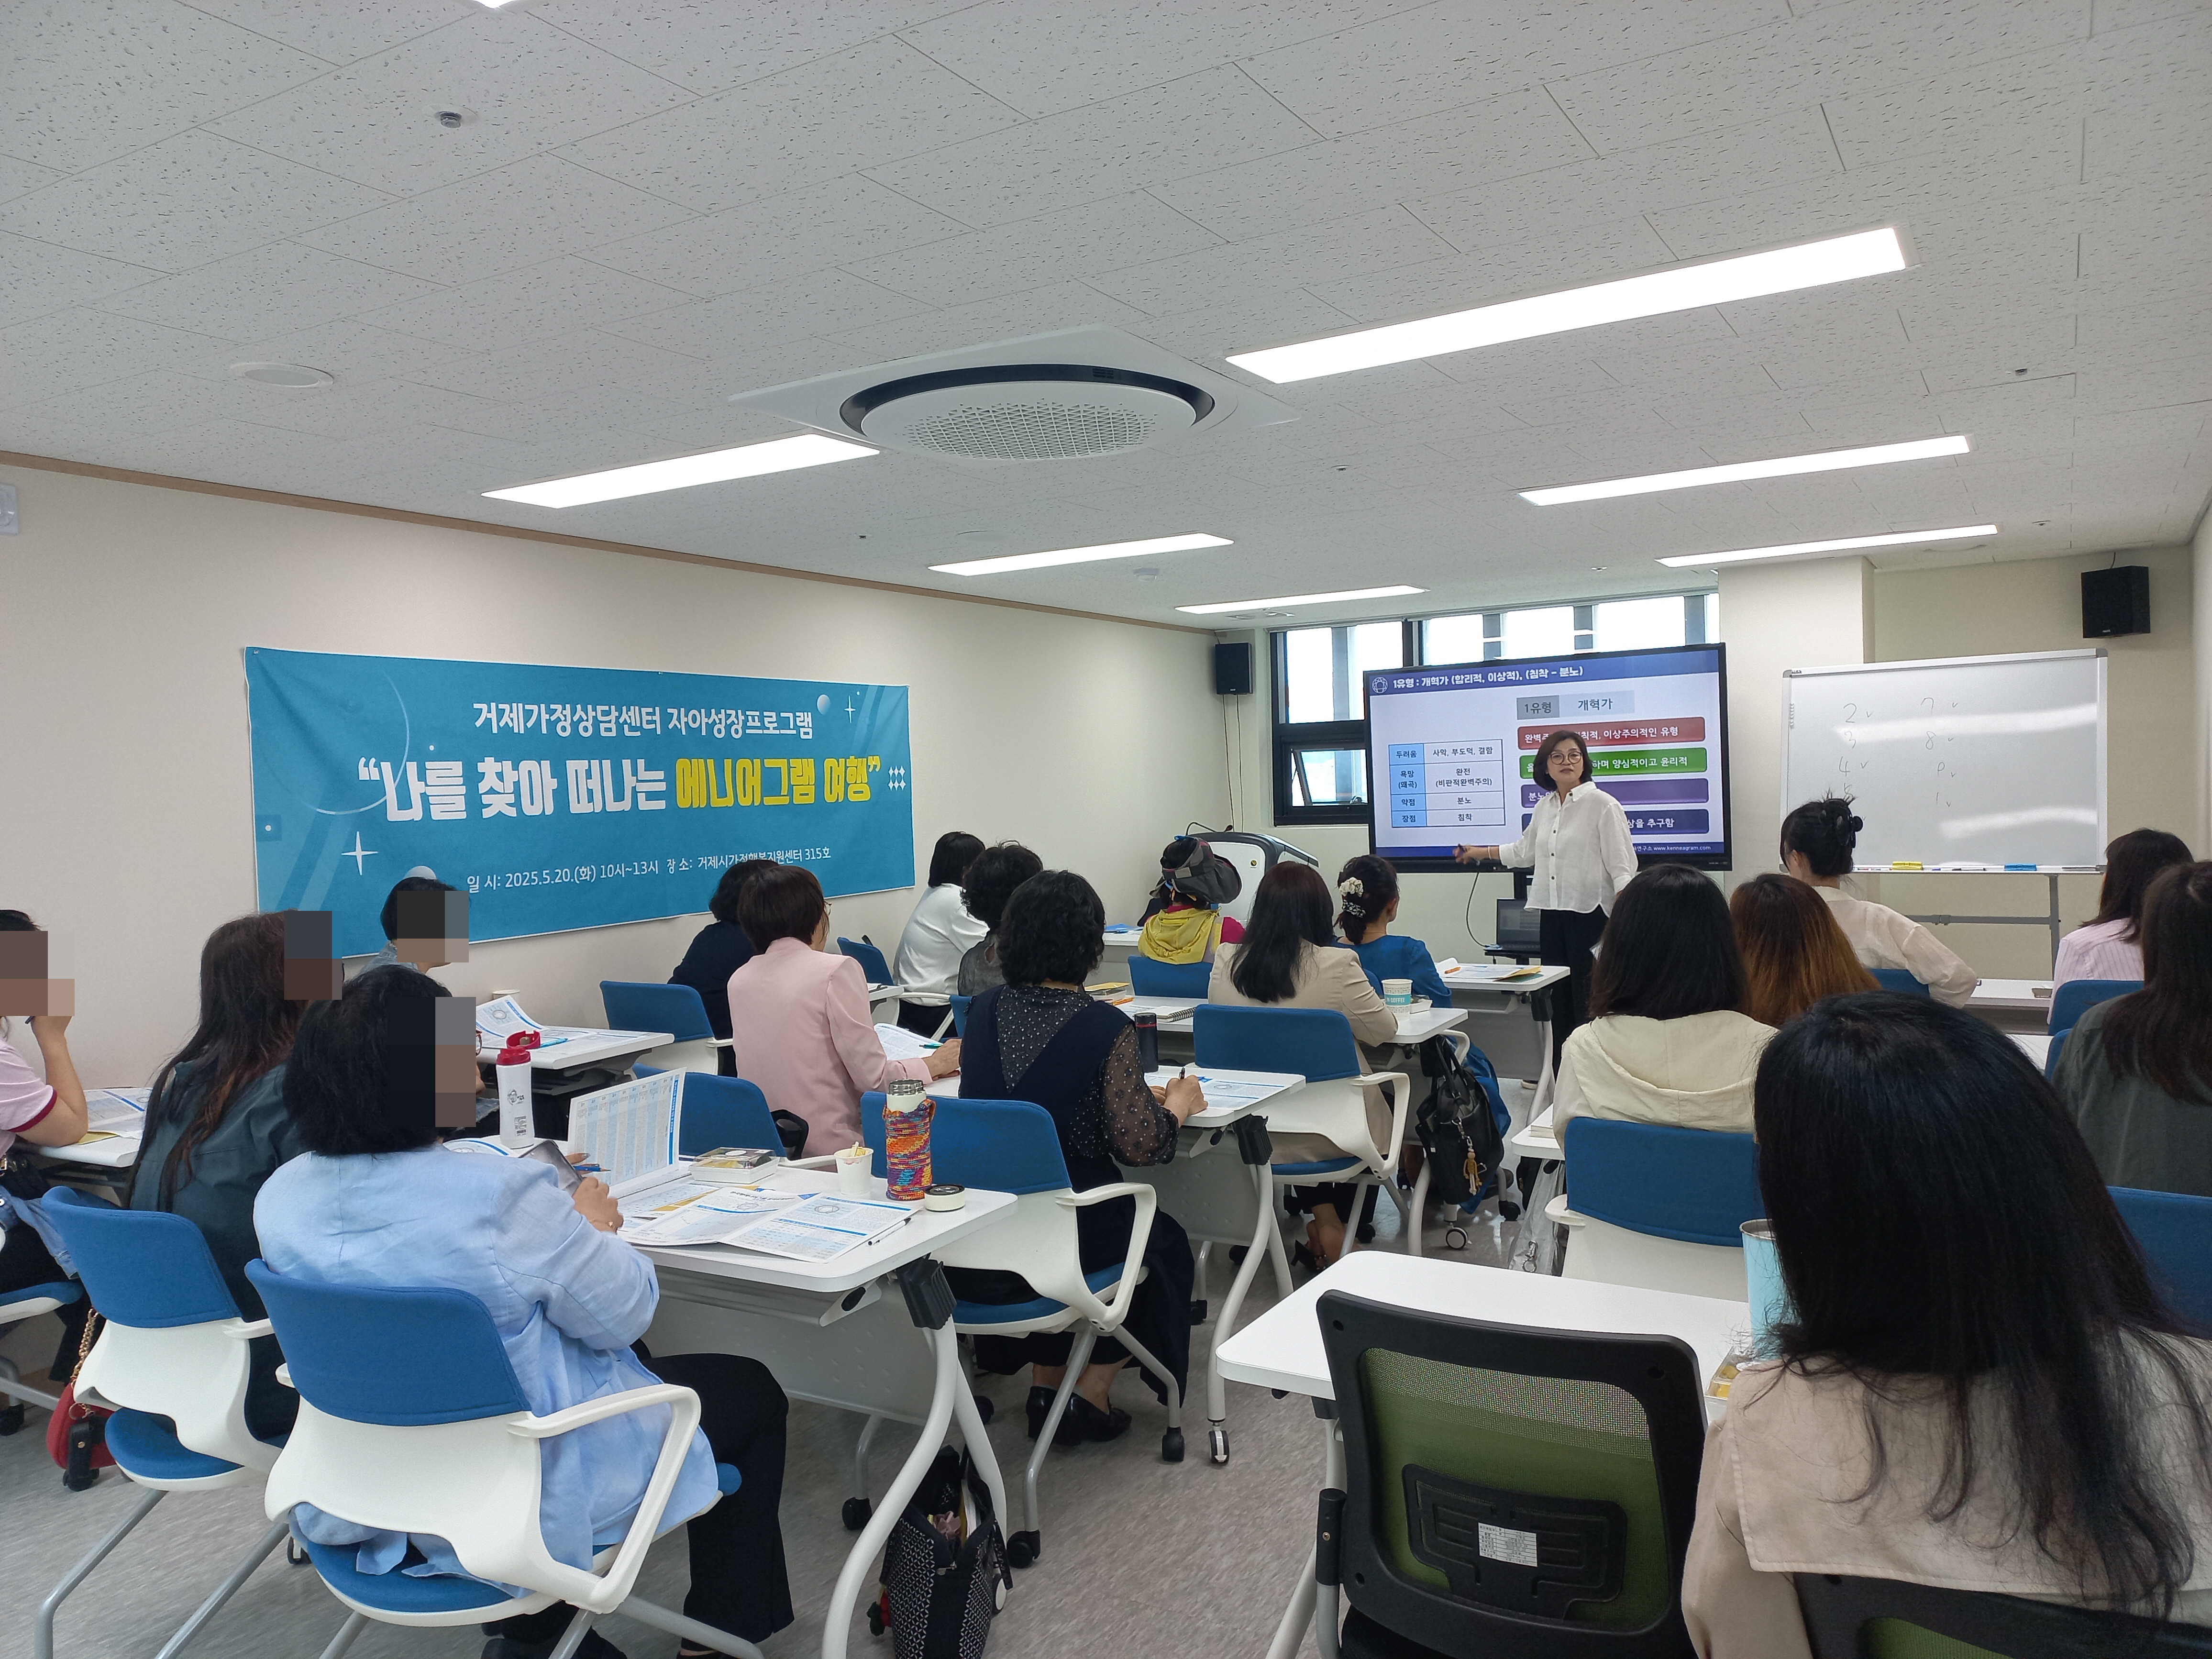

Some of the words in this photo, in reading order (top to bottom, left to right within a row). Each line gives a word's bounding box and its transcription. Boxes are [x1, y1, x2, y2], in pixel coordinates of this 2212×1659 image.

[1393, 678, 1415, 688] 1유형
[1421, 676, 1449, 686] 개혁가
[1451, 673, 1485, 686] (합리적,
[1488, 671, 1523, 683] 이상적),
[1526, 668, 1548, 680] (침착
[1559, 666, 1583, 677] 분노)
[1525, 702, 1551, 714] 1유형
[1578, 697, 1613, 711] 개혁가
[1843, 703, 1857, 723] 2
[473, 702, 660, 738] 거제가정상담센터
[667, 707, 813, 739] 자아성장프로그램
[1577, 730, 1601, 741] 칙적,
[1604, 727, 1657, 740] 이상주의적인
[1660, 726, 1679, 737] 유형
[1451, 747, 1475, 756] 부도덕,
[1478, 746, 1493, 754] 결함
[1613, 758, 1658, 769] 양심적이고
[1660, 757, 1687, 767] 윤리적
[358, 757, 467, 821] “나를
[477, 757, 558, 818] 찾아
[565, 759, 666, 813] 떠나는
[675, 757, 816, 808] 에니어그램
[823, 755, 881, 803] 여행”
[1398, 781, 1417, 789] (왜곡)
[1436, 778, 1492, 787] (비판적완벽주의)
[1458, 813, 1472, 821] 침착
[1647, 818, 1674, 828] 추구함
[467, 876, 479, 893] 일
[484, 874, 501, 890] 시:
[505, 865, 596, 888] 2025.5.20.(화)
[600, 860, 658, 879] 10시~13시
[666, 858, 676, 874] 장
[679, 859, 693, 872] 소:
[805, 846, 831, 861] 315호
